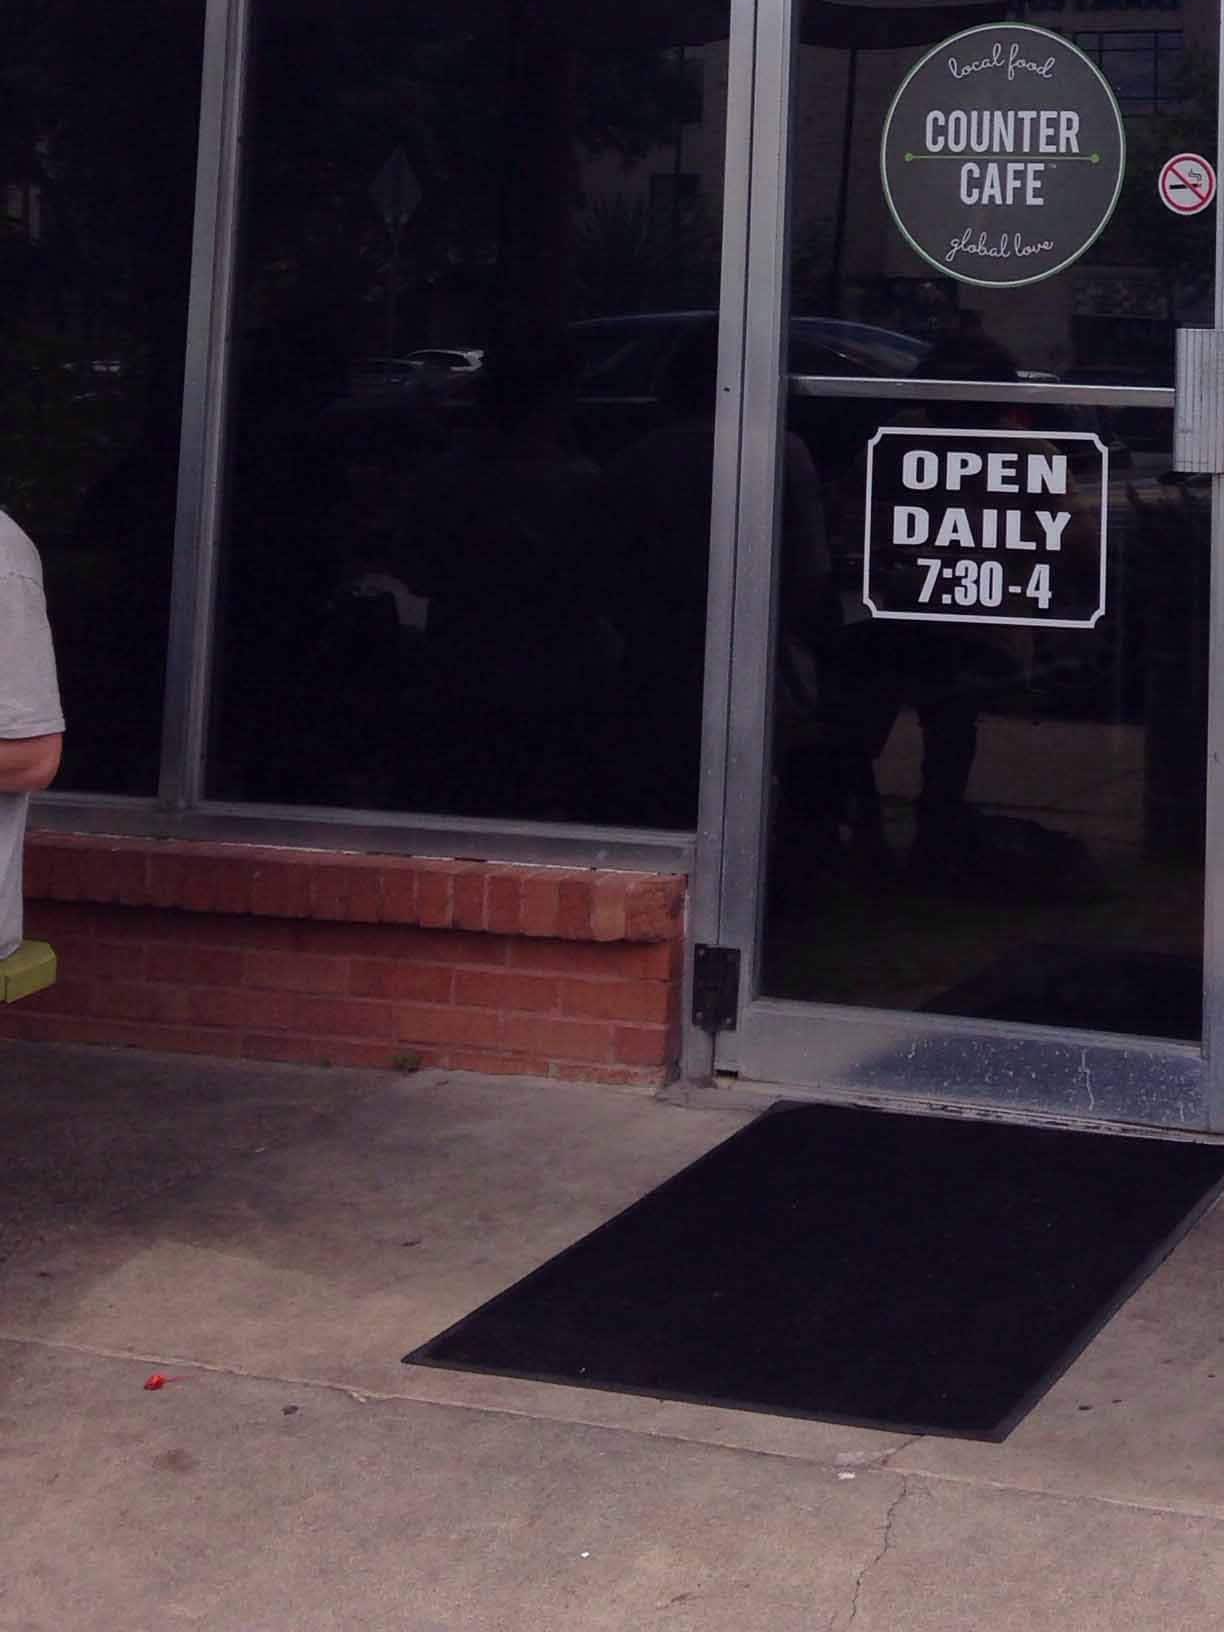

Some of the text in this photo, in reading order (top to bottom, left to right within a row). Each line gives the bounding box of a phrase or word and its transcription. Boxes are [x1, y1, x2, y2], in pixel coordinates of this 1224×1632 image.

[948, 43, 1056, 81] local food
[925, 110, 1080, 153] COUNTER
[960, 162, 1045, 206] CAFE
[946, 228, 1055, 262] global love
[901, 449, 1068, 495] OPEN
[892, 505, 1072, 552] DAILY
